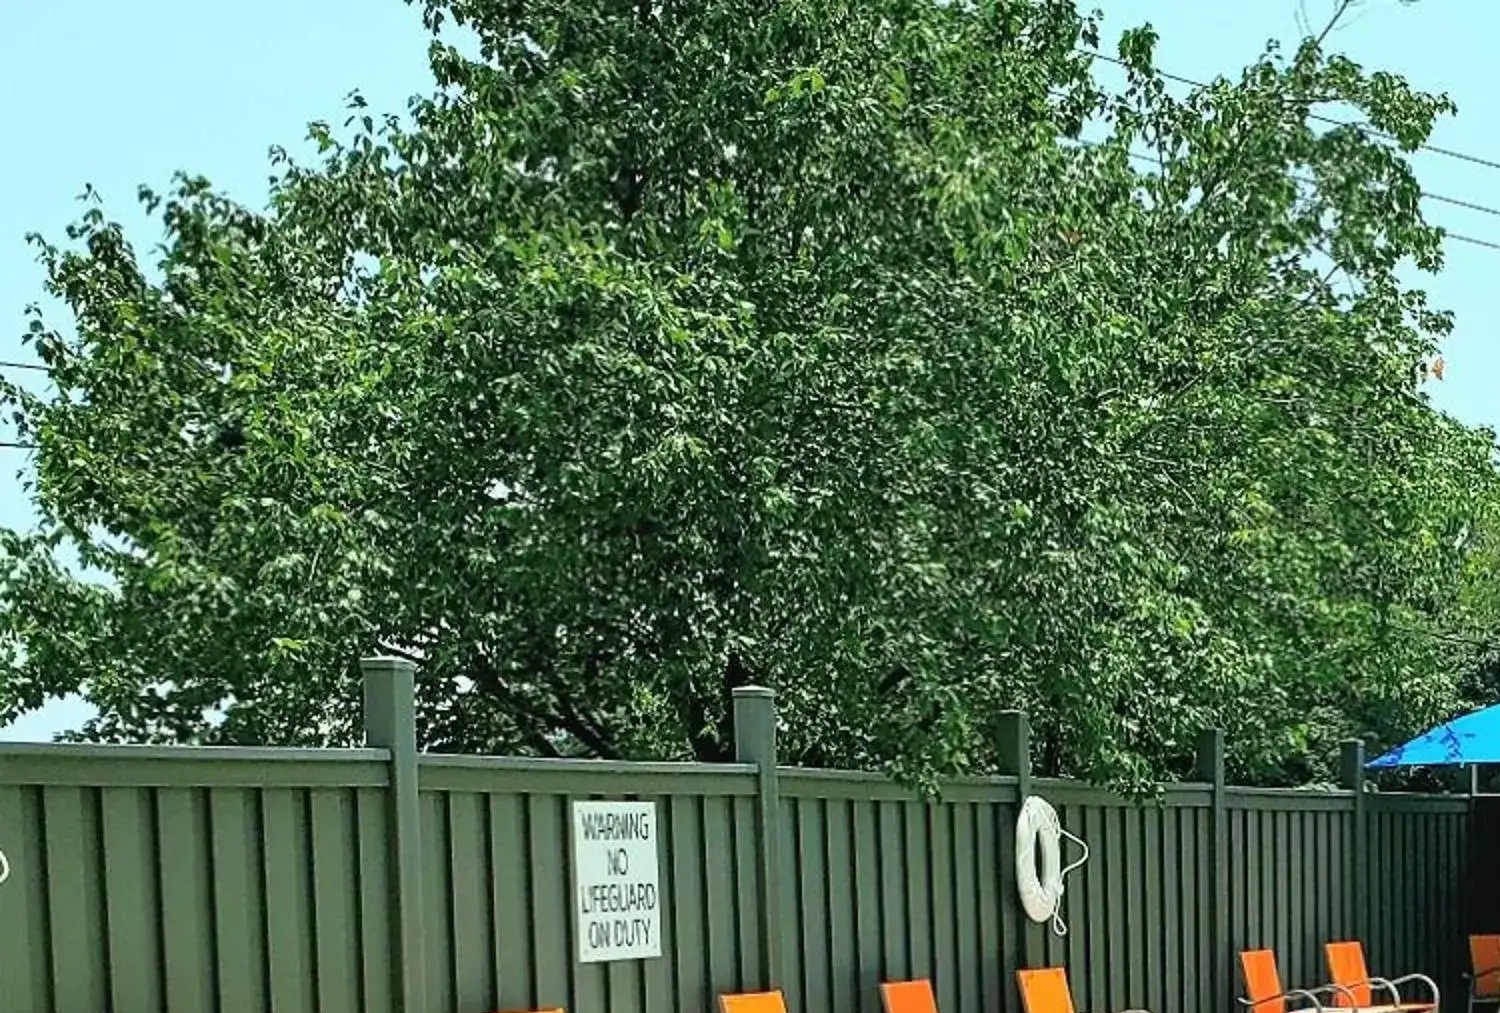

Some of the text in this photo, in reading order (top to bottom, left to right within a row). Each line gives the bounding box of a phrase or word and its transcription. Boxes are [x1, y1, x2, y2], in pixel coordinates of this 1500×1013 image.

[581, 812, 649, 840] WARNING
[607, 848, 629, 875] NO
[581, 883, 656, 913] LIFEGUARD
[589, 918, 651, 948] ON DUTY
